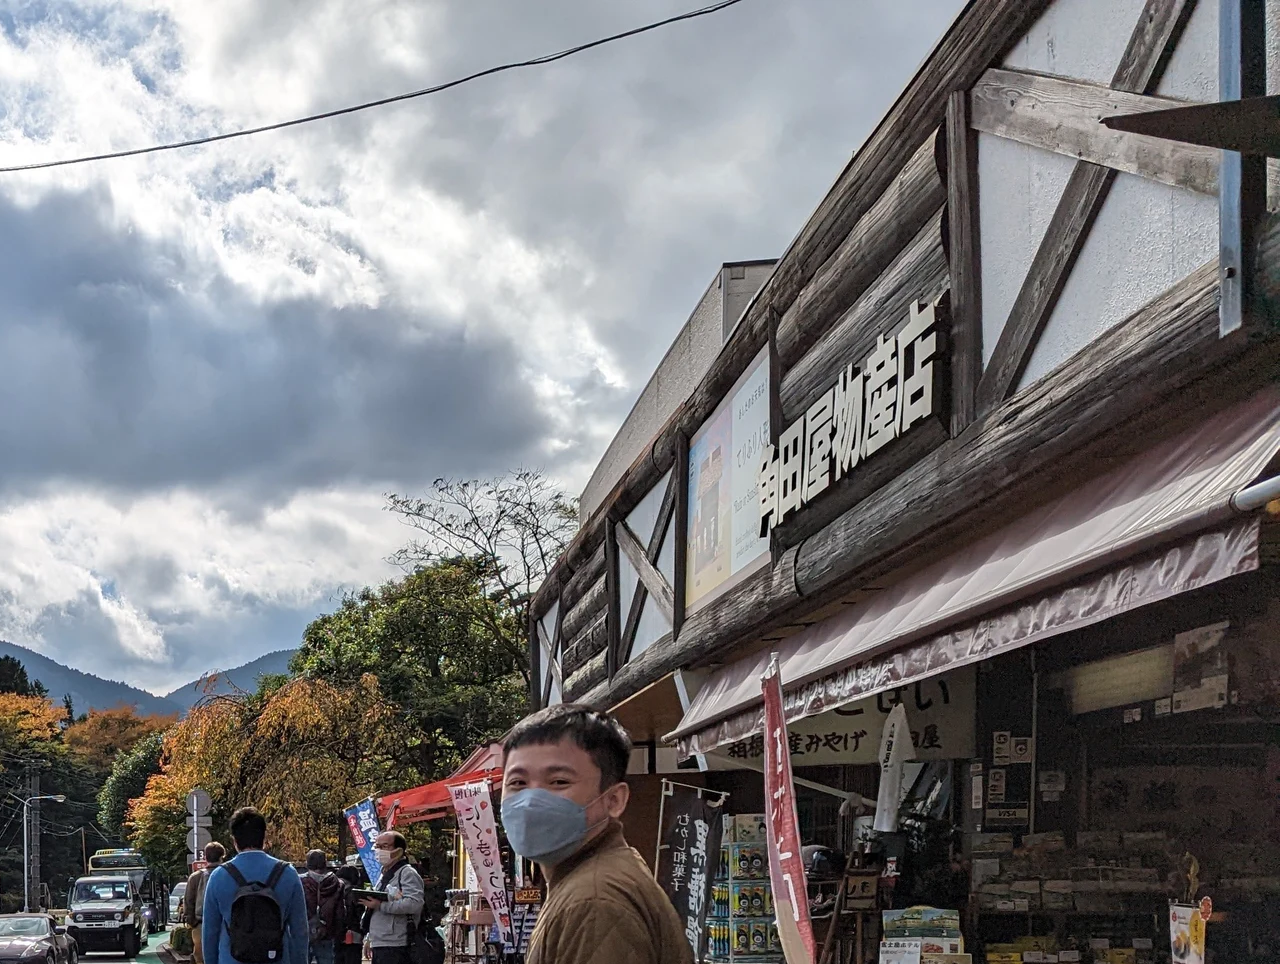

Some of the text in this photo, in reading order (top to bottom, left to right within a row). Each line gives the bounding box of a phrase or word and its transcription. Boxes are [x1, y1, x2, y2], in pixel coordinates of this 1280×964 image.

[728, 731, 867, 758] 箱根産みやげ
